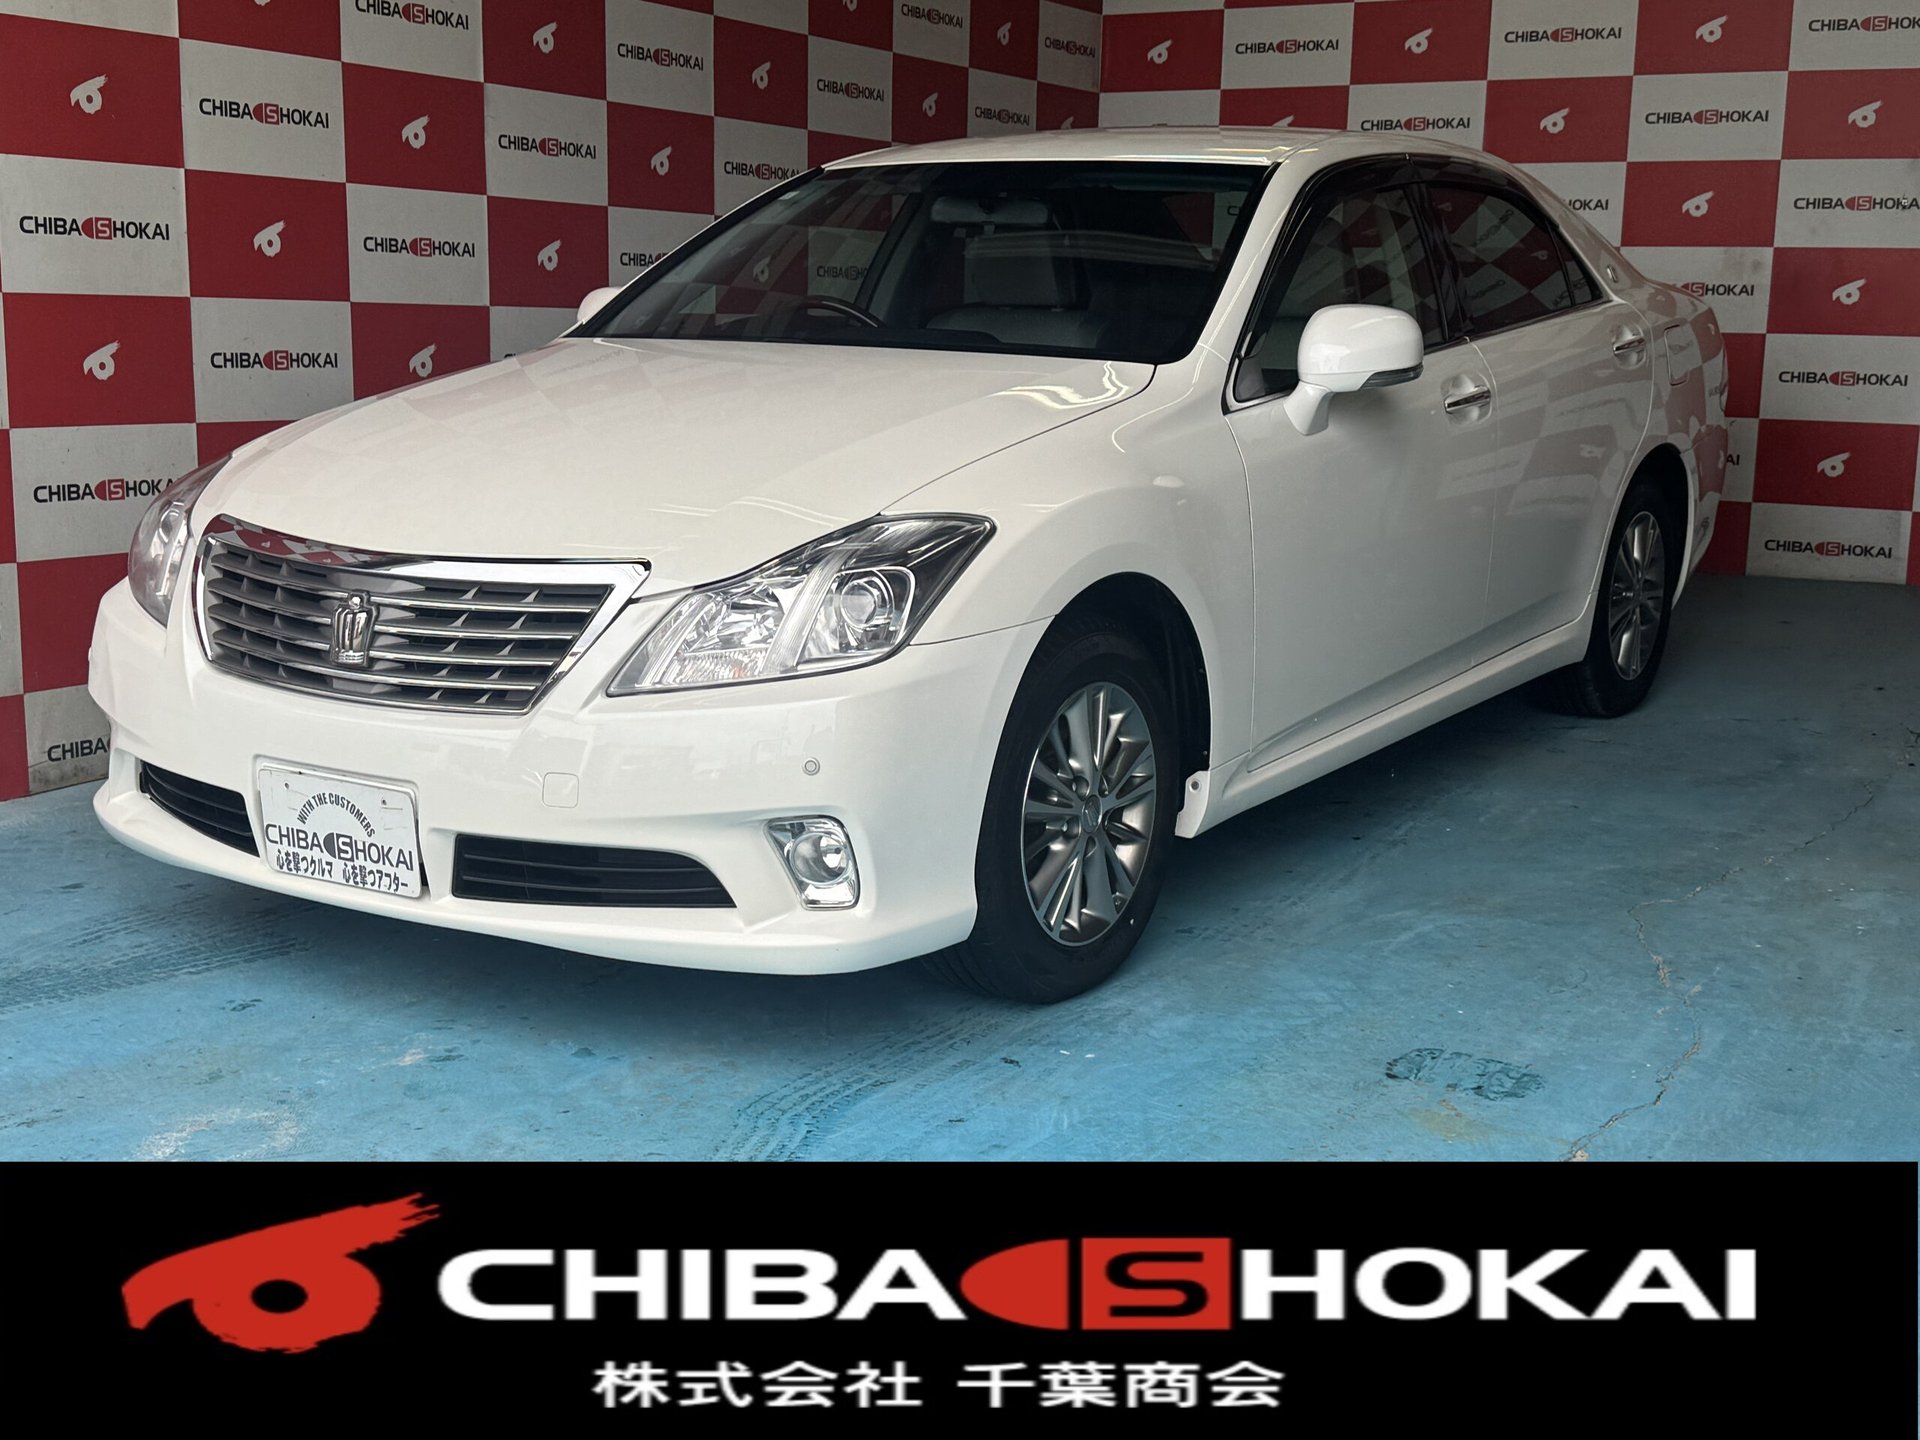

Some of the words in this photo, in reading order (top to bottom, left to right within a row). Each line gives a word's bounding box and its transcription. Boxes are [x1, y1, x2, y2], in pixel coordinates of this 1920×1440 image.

[762, 164, 801, 180] SHOKA
[109, 478, 178, 500] SHOKA
[297, 796, 315, 825] WITH
[311, 792, 329, 808] THE
[328, 792, 376, 838] CUSTOMERS
[265, 823, 324, 853] CHIBA
[336, 833, 414, 871] SHOKAI
